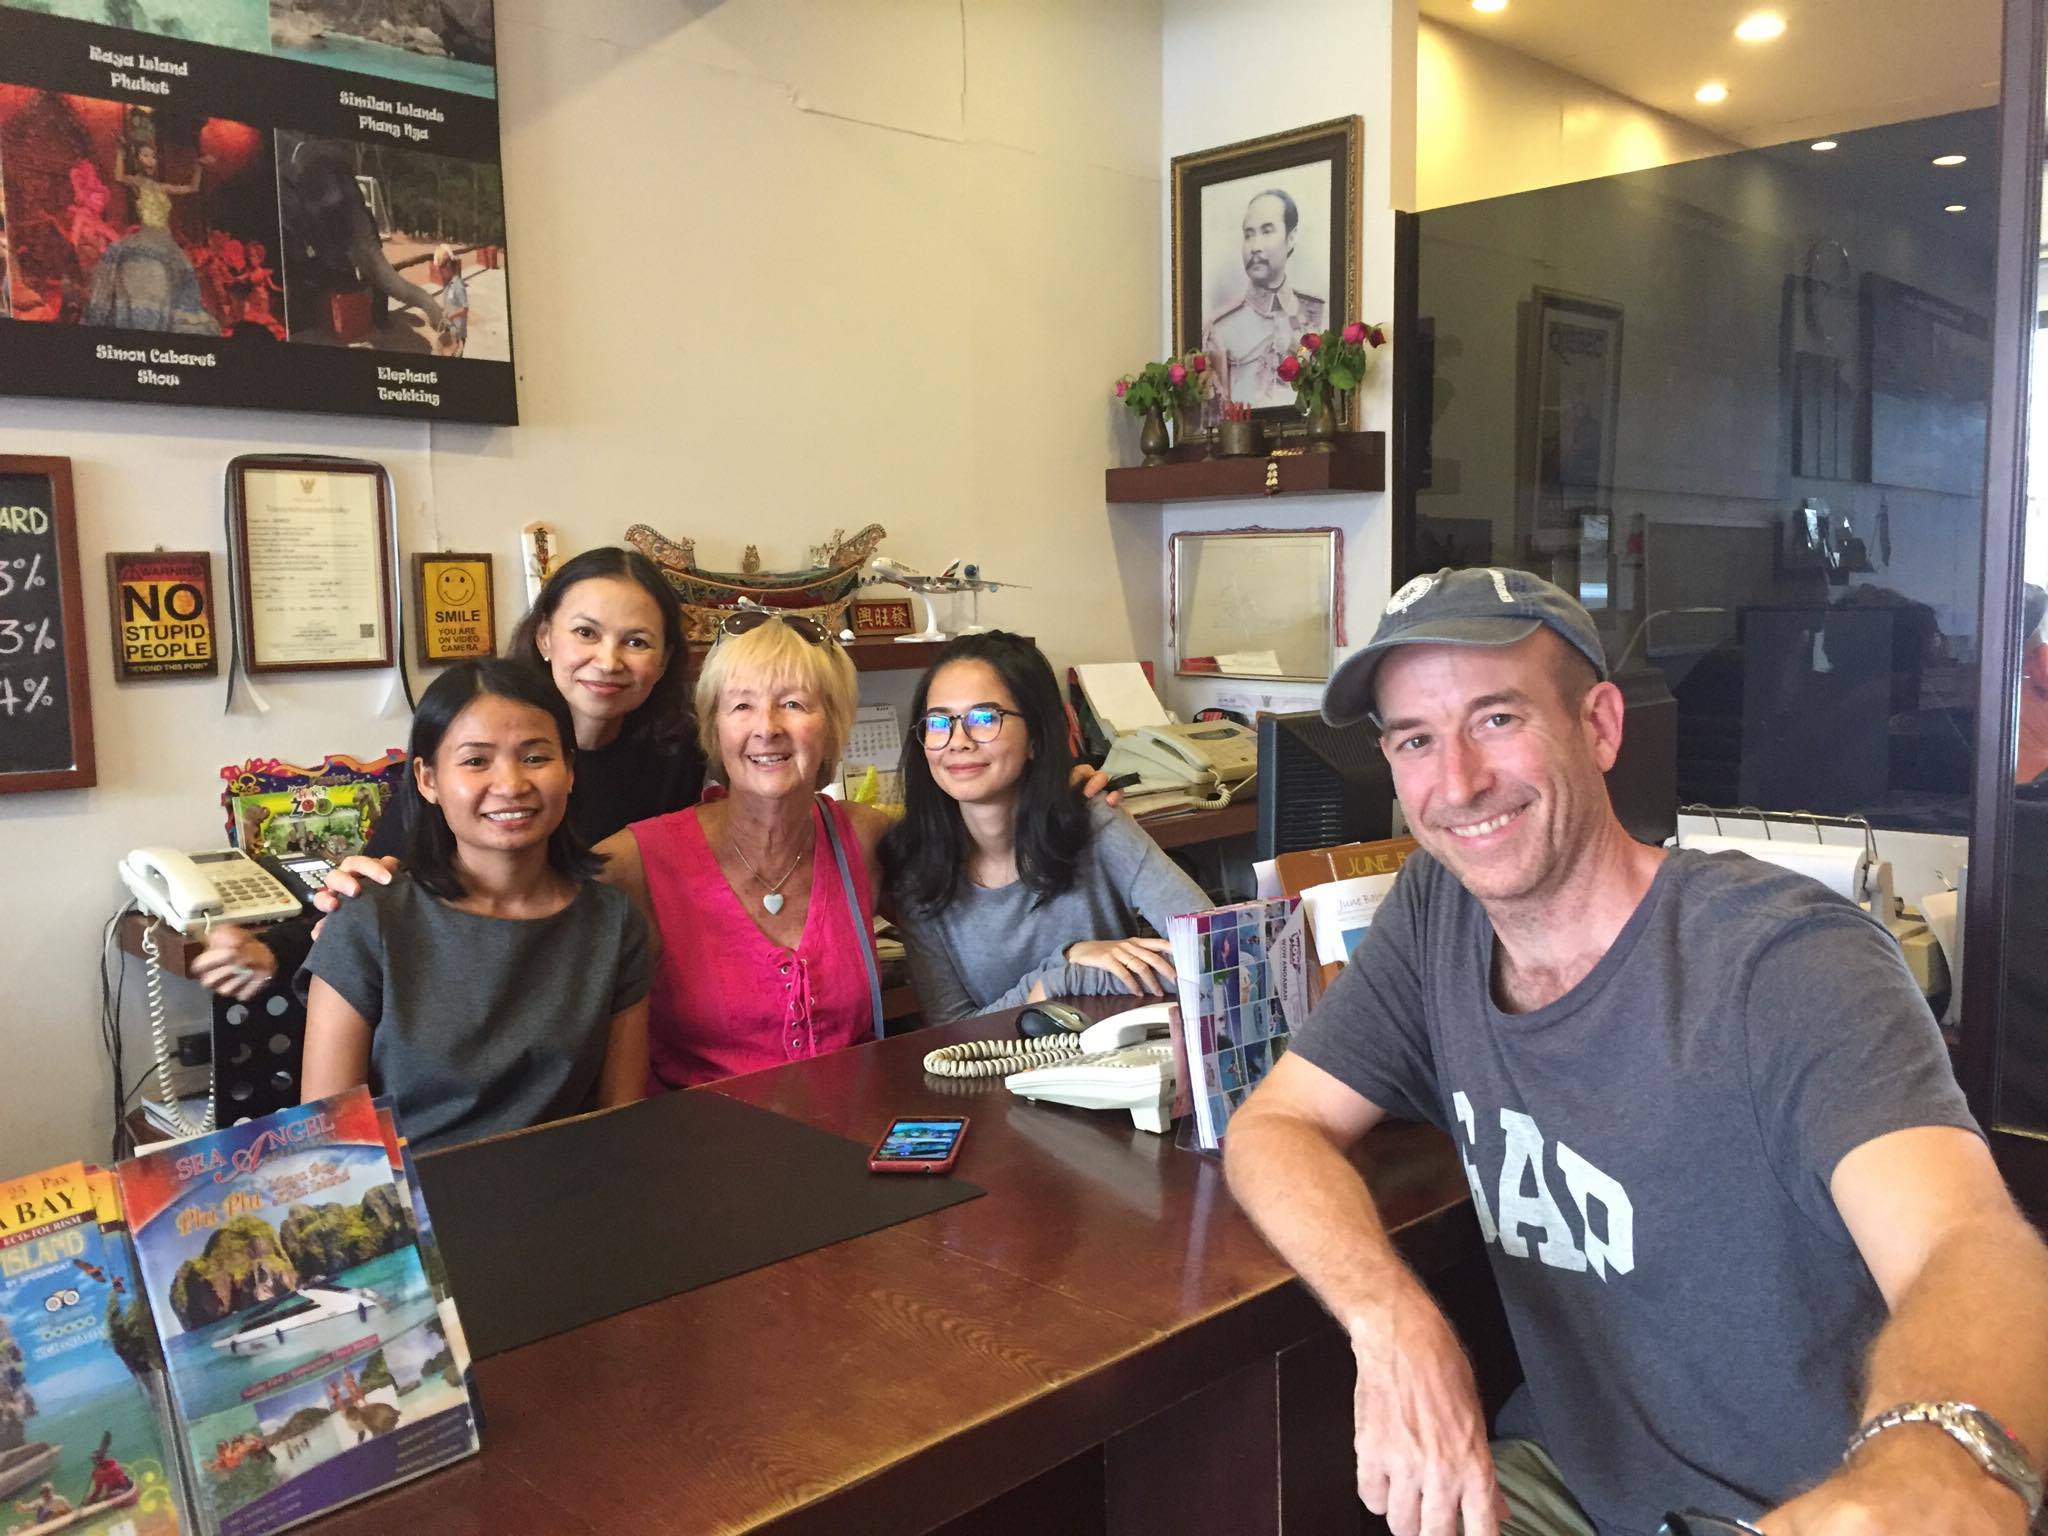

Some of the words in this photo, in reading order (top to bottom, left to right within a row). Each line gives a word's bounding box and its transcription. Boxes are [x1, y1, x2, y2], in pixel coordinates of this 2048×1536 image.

[89, 45, 134, 68] Raya
[139, 54, 188, 76] Island
[111, 72, 169, 95] Phuket
[340, 90, 392, 113] Similan
[396, 102, 444, 122] Islands
[359, 115, 400, 137] Phang
[403, 123, 428, 141] Nga
[96, 344, 147, 363] Simon
[150, 348, 216, 367] Cabaret
[138, 369, 180, 386] Show
[377, 367, 438, 384] Elephant
[377, 387, 440, 406] Trekking
[123, 583, 204, 622] NO
[435, 610, 480, 623] SMILE
[0, 617, 56, 654] 3%
[126, 624, 205, 641] STUPID
[453, 635, 480, 643] VIDEO
[458, 627, 476, 635] ARE
[126, 642, 208, 659] PEOPLE
[441, 644, 479, 652] CAMERA
[1345, 854, 1395, 877] JUNE
[176, 1148, 227, 1181] SEA
[214, 1113, 335, 1184] ANGEL
[16, 1187, 75, 1224] BAY
[1, 1229, 86, 1277] ISLAND
